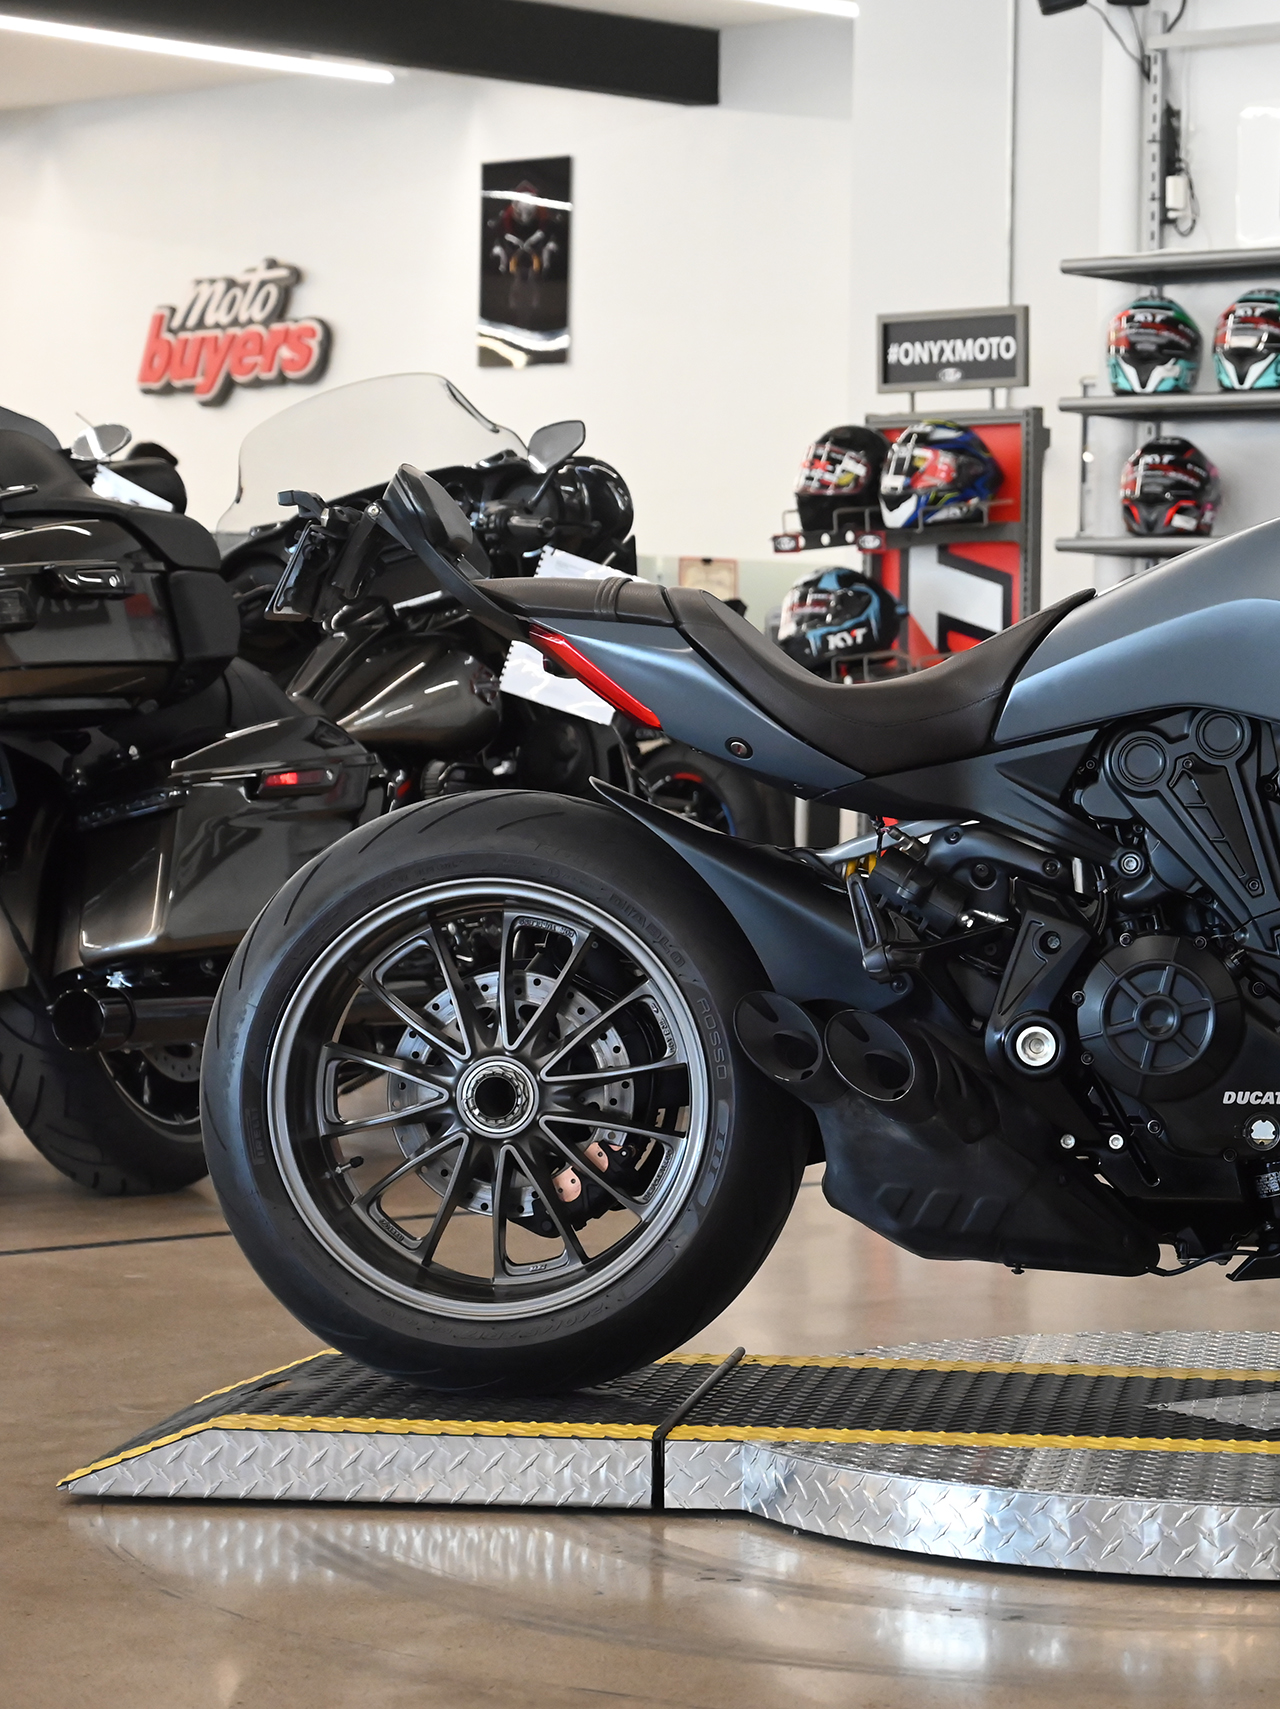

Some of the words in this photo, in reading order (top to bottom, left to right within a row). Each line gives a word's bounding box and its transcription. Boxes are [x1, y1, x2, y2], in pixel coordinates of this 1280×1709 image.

[137, 312, 318, 395] buyers
[887, 335, 1017, 367] #ONYXMOTO
[826, 627, 868, 651] KYT
[697, 997, 728, 1080] ROSSO
